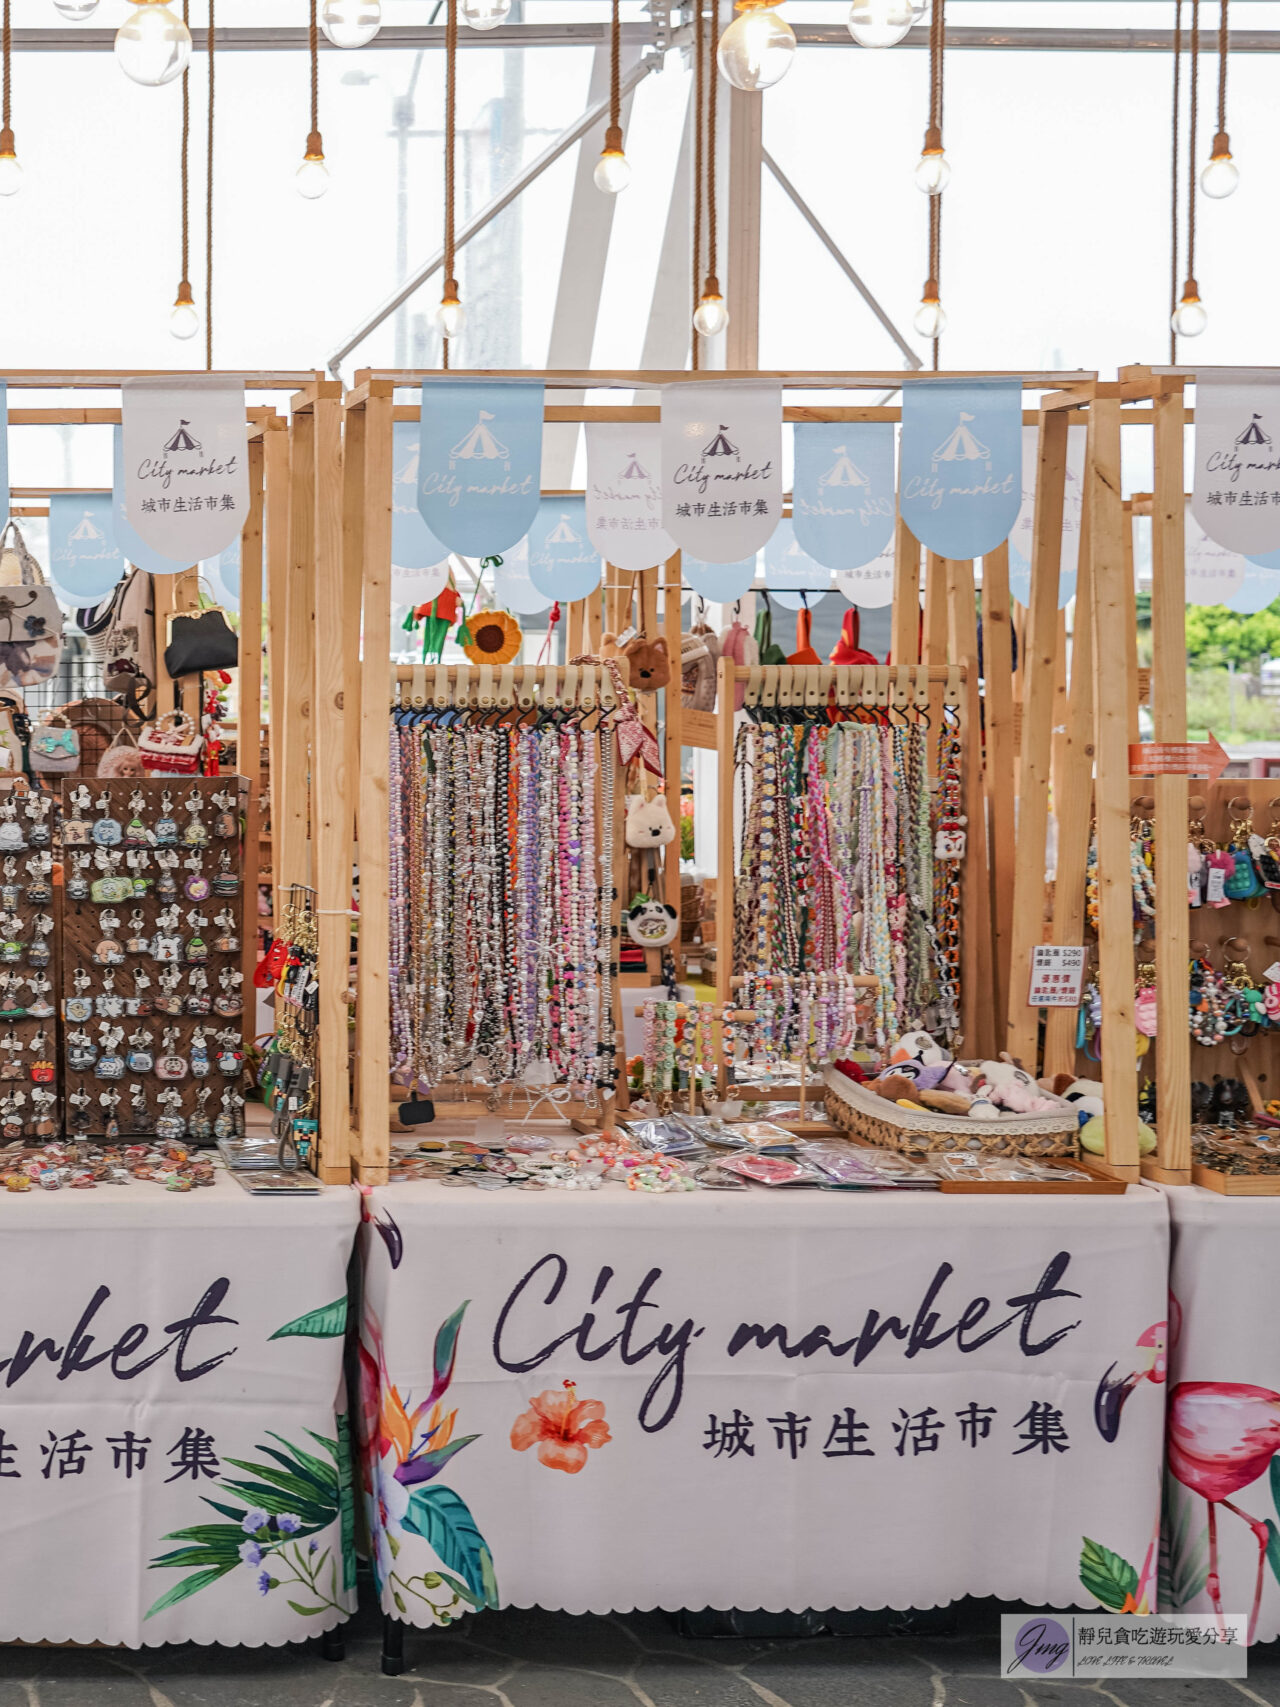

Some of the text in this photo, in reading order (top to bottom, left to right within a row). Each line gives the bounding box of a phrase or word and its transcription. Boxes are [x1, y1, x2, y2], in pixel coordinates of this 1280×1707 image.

[137, 456, 238, 489] City market
[673, 461, 773, 494] City market
[1206, 451, 1280, 483] City mar
[140, 494, 236, 513] 城市生活市集
[423, 471, 534, 507] City market
[903, 473, 1016, 509] City market
[1206, 490, 1280, 507] 城市生活市
[675, 499, 769, 517] 城市生活市集
[845, 570, 892, 580] 城市生活市
[493, 1250, 1082, 1433] City market
[703, 1400, 1072, 1459] 城市生活市集
